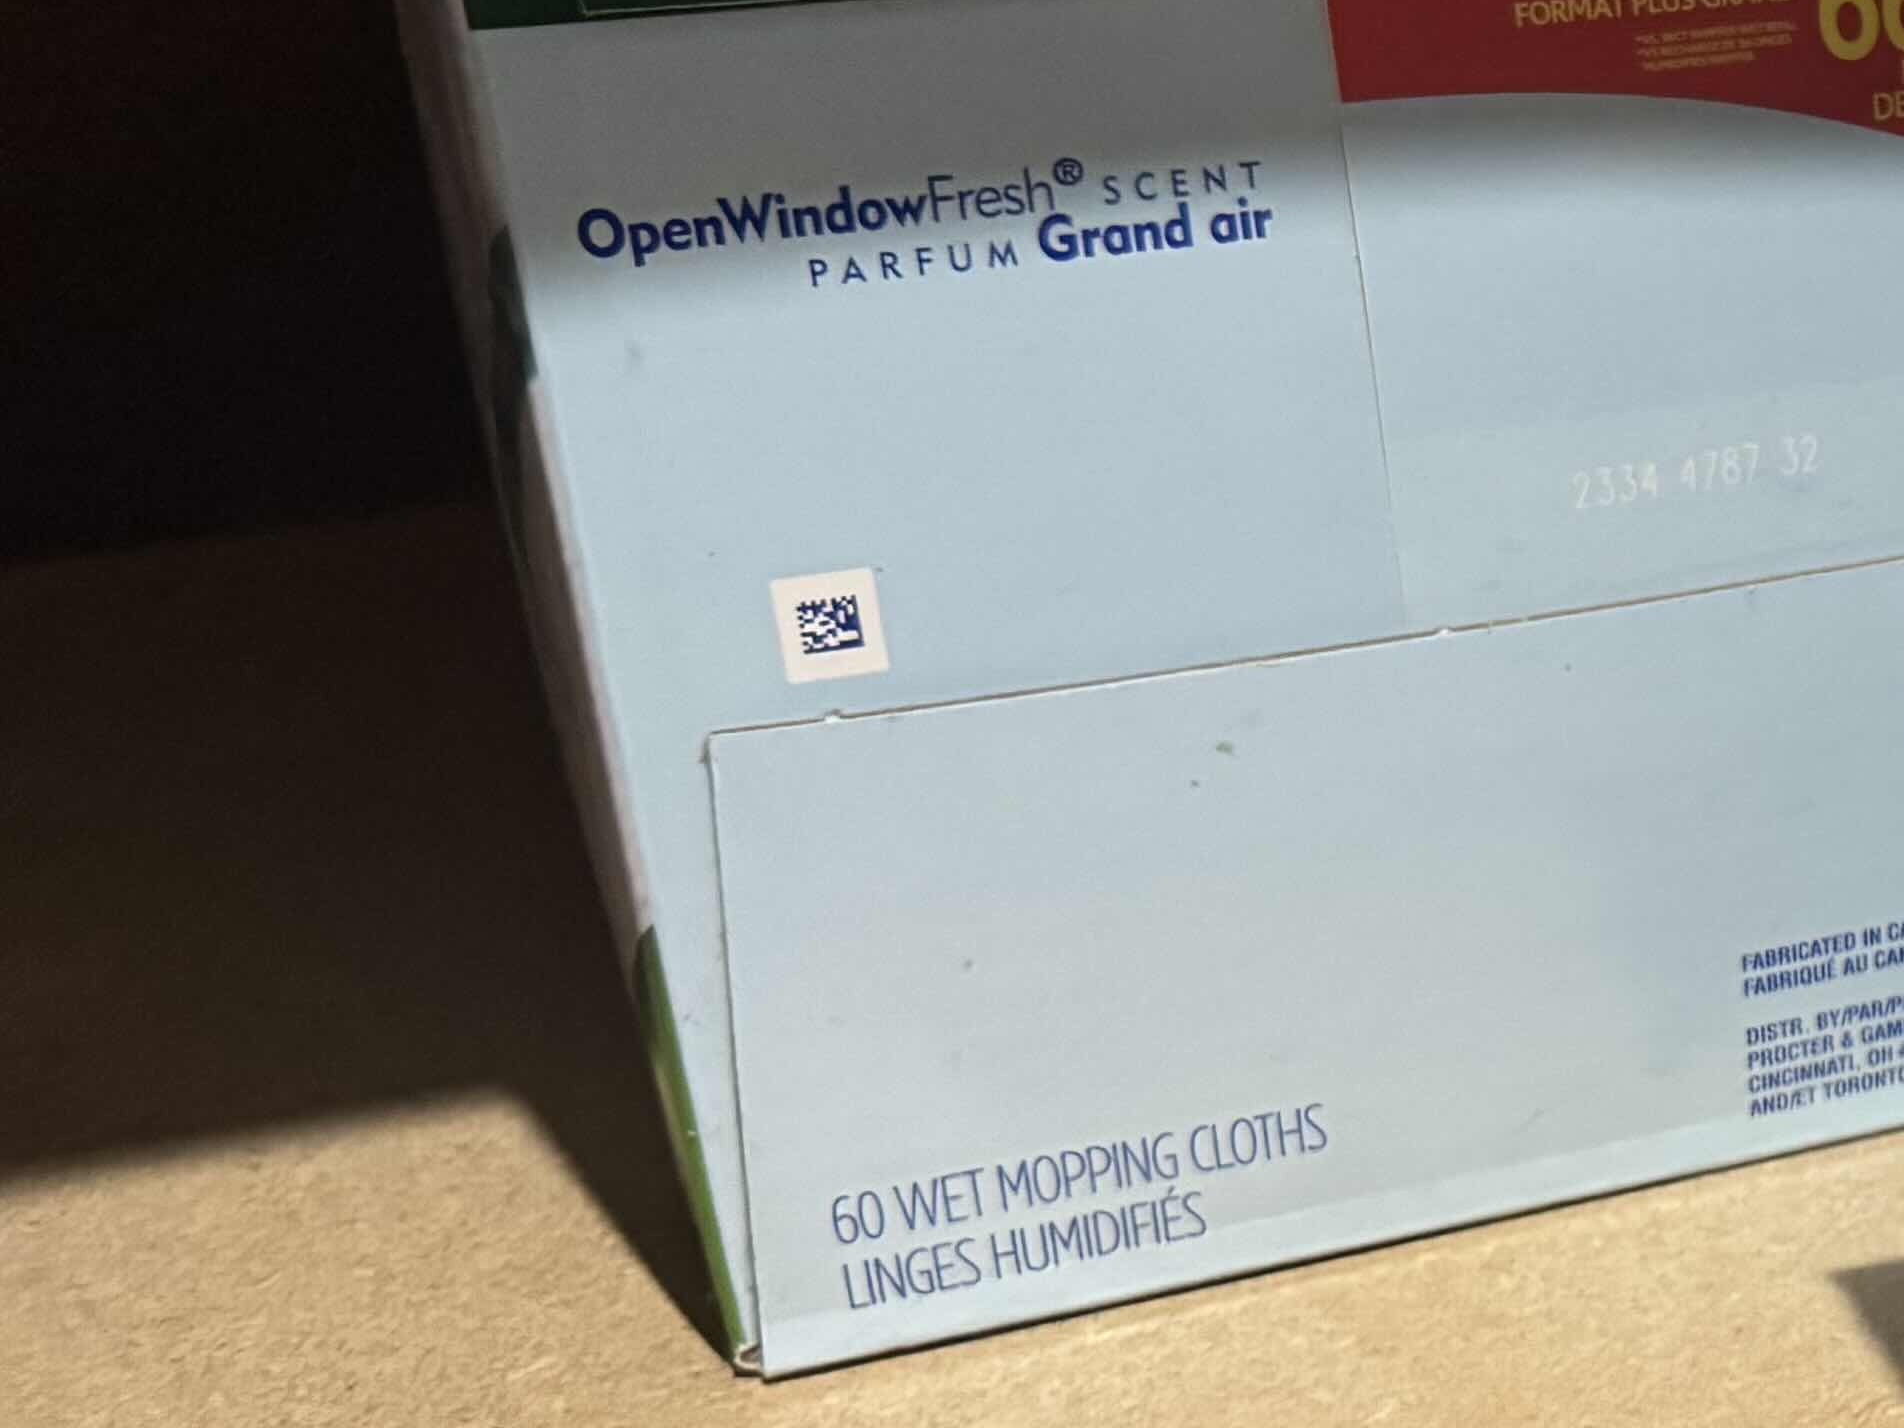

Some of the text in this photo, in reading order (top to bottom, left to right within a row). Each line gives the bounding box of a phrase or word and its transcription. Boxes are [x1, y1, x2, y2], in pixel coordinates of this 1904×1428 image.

[1102, 161, 1264, 207] SCENT
[807, 197, 1275, 289] PARFUM Grand air
[1569, 434, 1821, 509] 2334 4787 32
[1742, 930, 1858, 972] FABRICATED
[1863, 926, 1882, 948] IN
[1743, 958, 1837, 997] FABRIQUÉ
[1843, 952, 1869, 976] AU
[831, 1102, 1330, 1245] 60 WET MOPPING CLOTHS
[842, 1186, 1208, 1310] LINGES HUMIDIFIÉS
